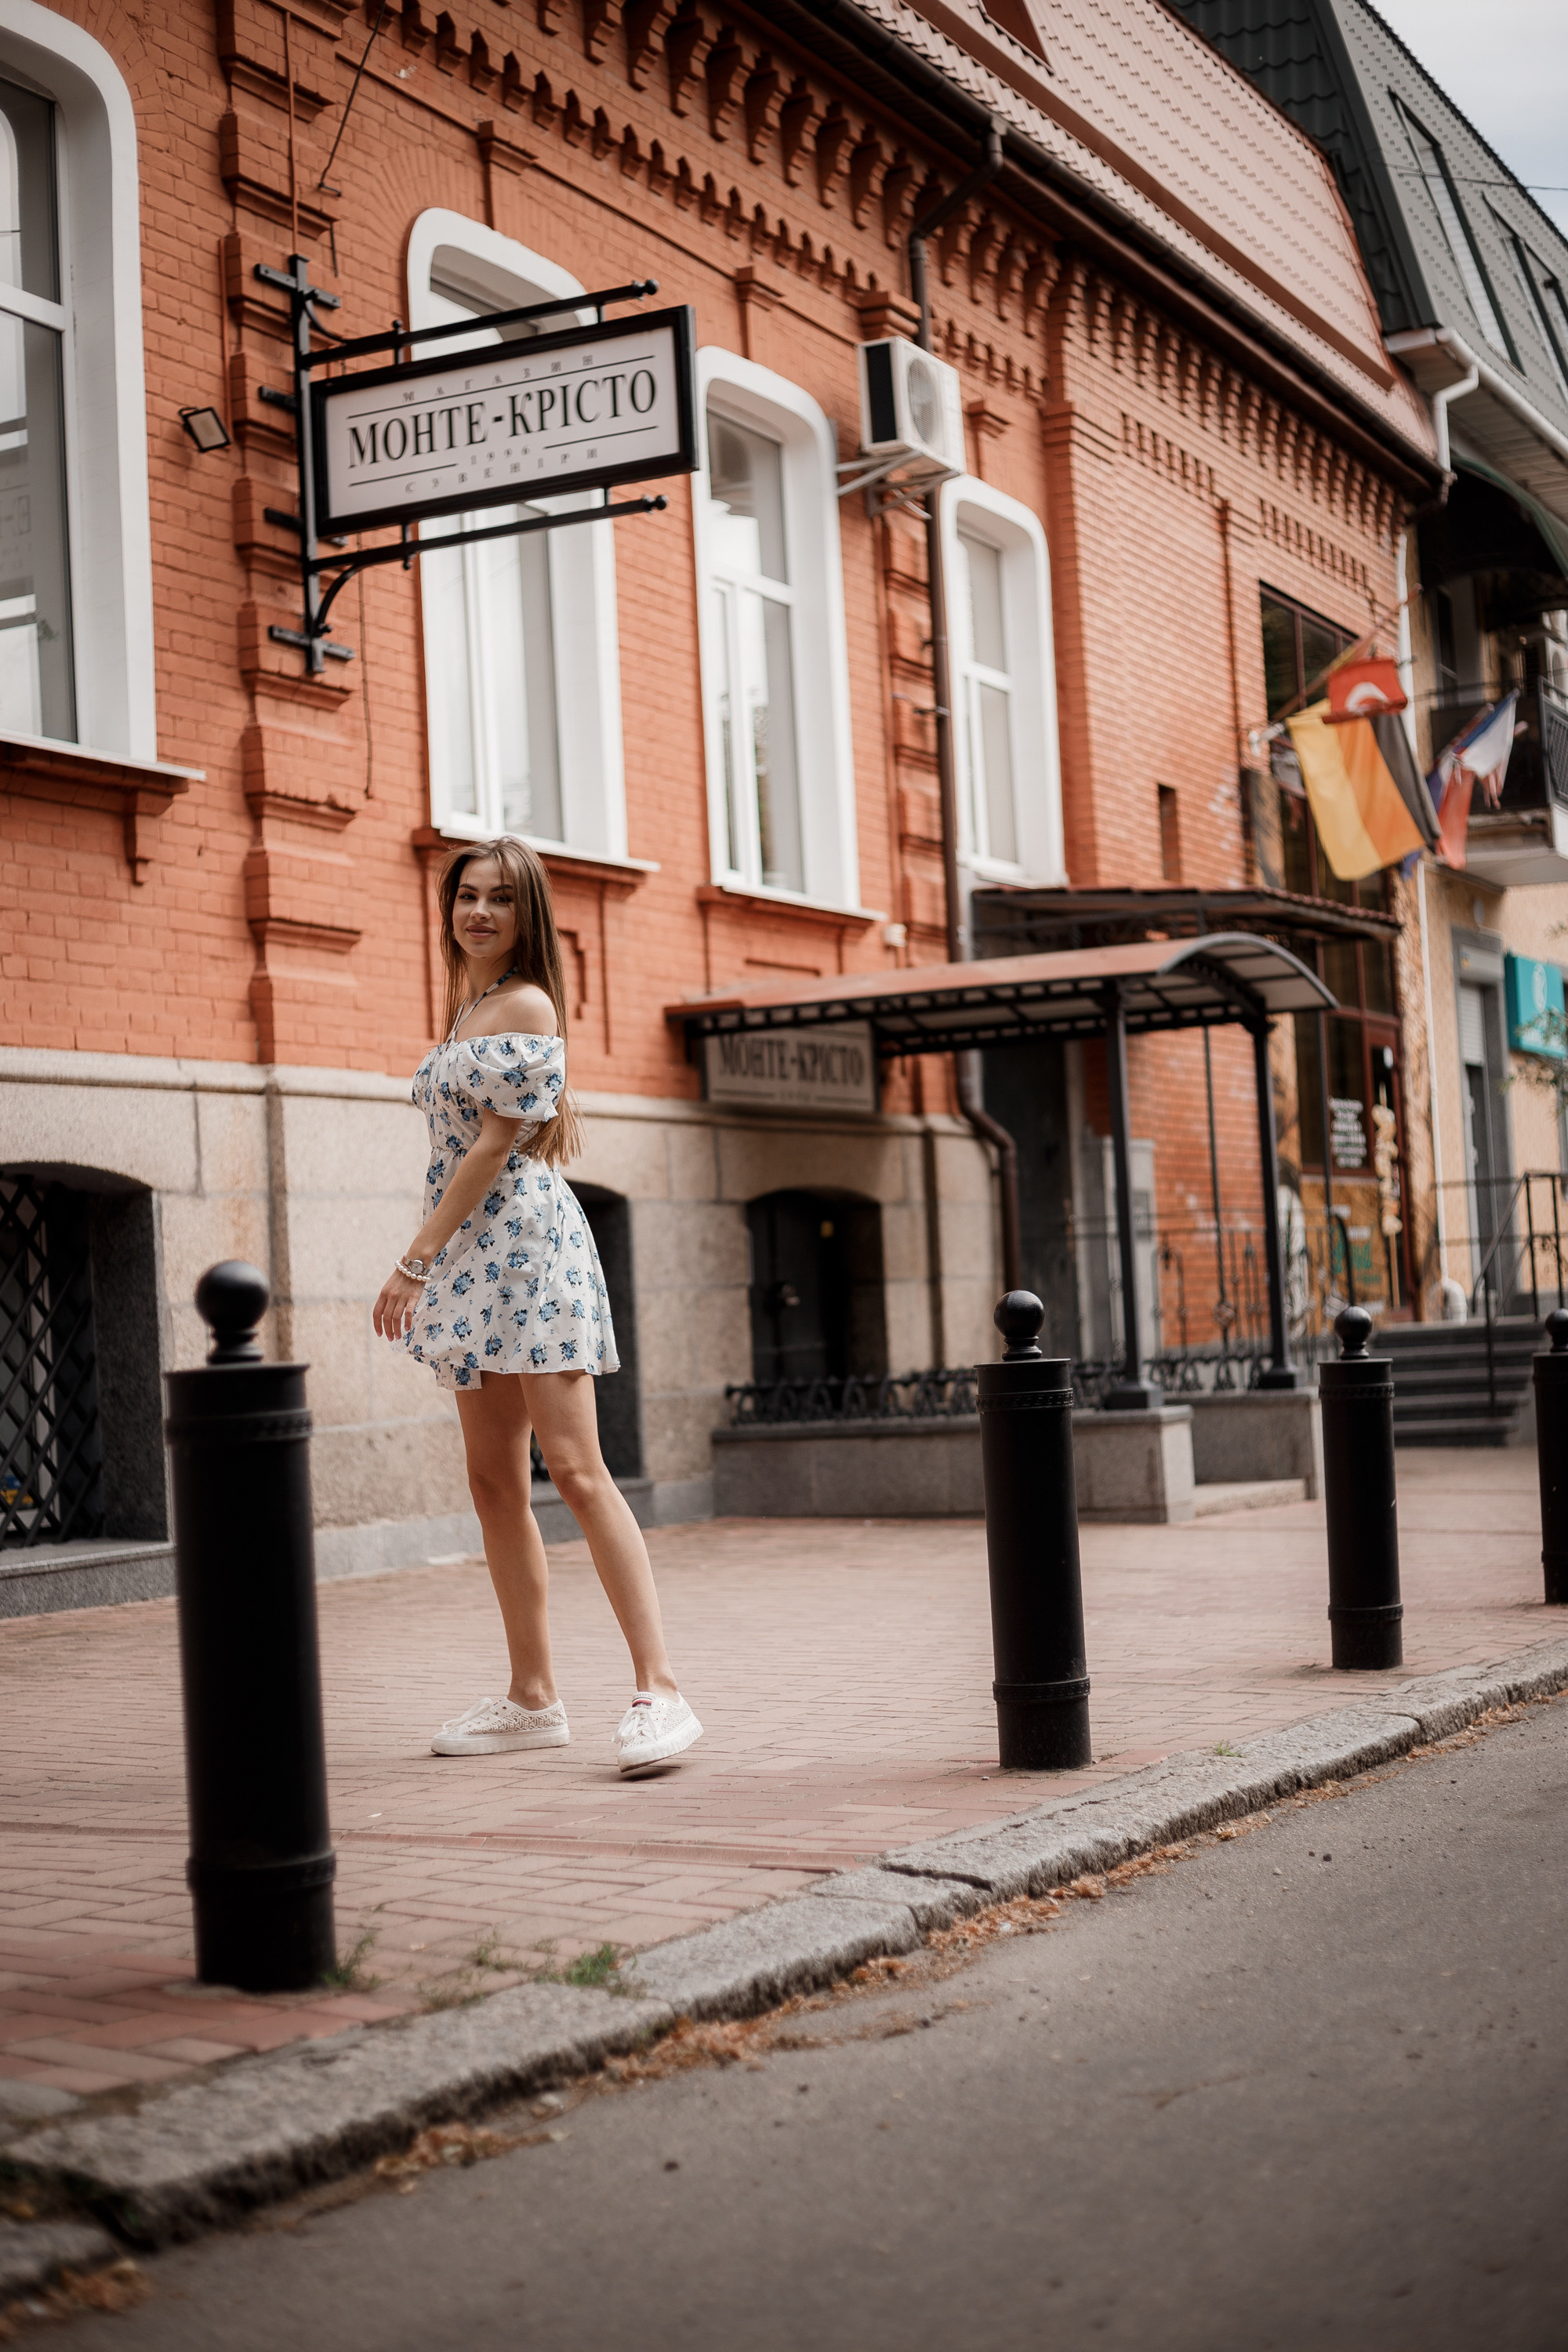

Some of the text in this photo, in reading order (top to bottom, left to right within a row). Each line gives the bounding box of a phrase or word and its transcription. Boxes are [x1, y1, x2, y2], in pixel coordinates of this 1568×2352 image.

[402, 354, 593, 402] МАГАЗИН
[347, 368, 657, 470] МОНТЕ-КРІСТО
[405, 447, 598, 494] СУВЕНІРИ
[470, 445, 531, 465] 1996
